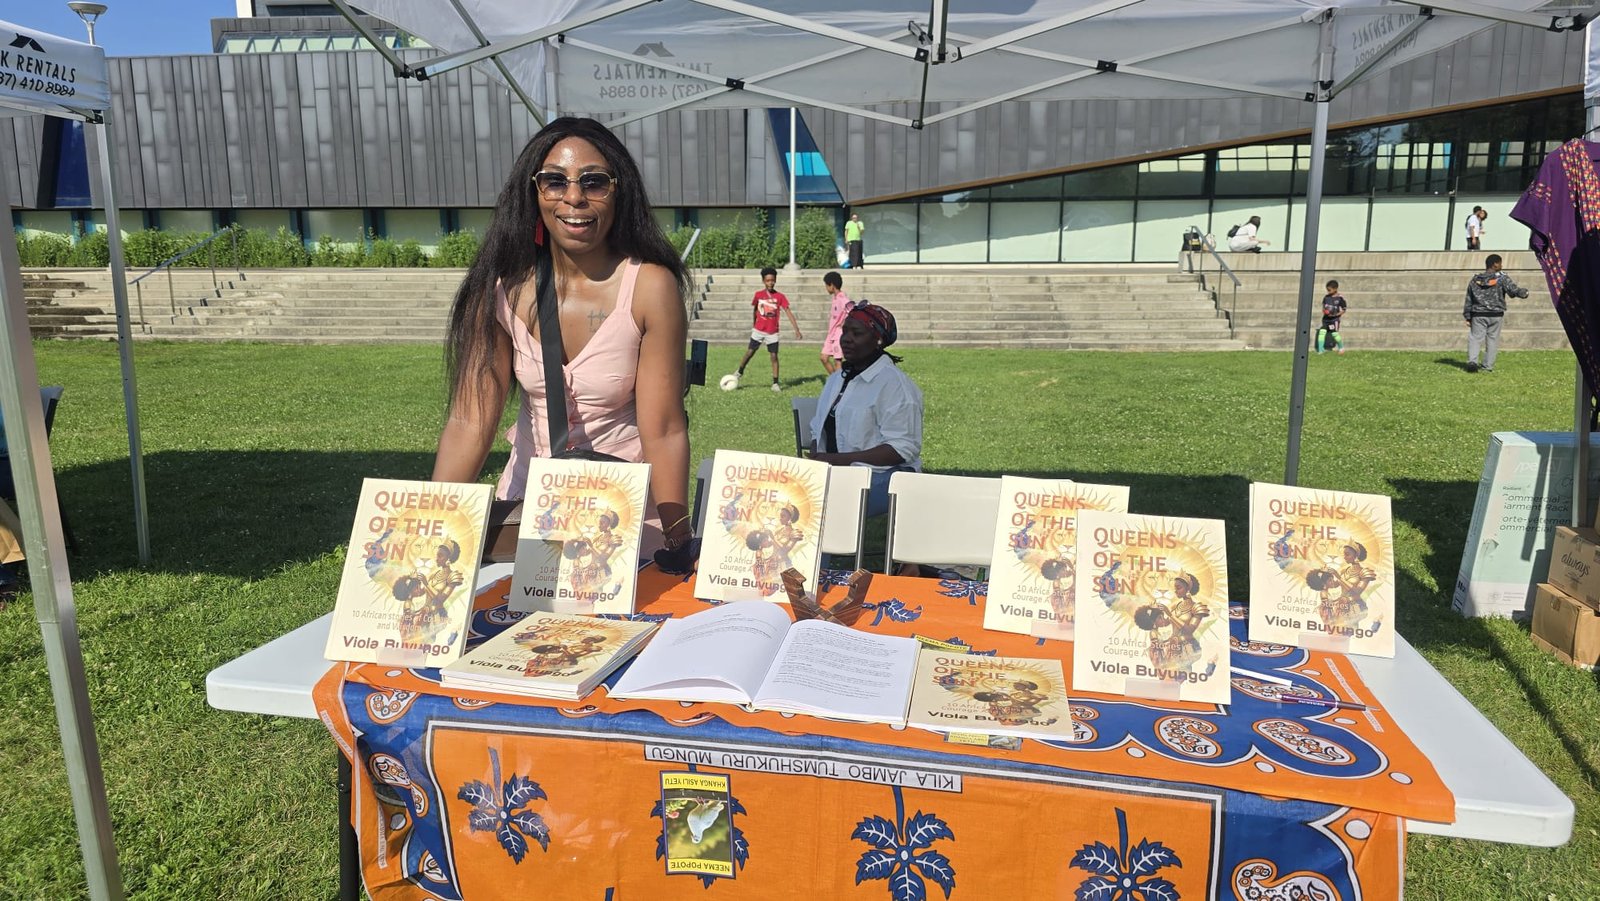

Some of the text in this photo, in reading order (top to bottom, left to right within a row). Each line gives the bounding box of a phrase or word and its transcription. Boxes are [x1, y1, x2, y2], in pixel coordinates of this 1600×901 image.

[16, 54, 76, 83] RENTALS
[20, 76, 44, 92] 410
[45, 81, 76, 97] 8984
[541, 473, 608, 491] QUEENS
[724, 465, 789, 484] QUEENS
[374, 490, 459, 512] QUEENS
[537, 494, 597, 510] OF THE
[721, 485, 778, 503] OF THE
[1014, 491, 1086, 510] QUEENS
[718, 505, 752, 522] SUN
[1269, 499, 1346, 520] QUEENS
[1545, 503, 1569, 512] Rack
[368, 516, 444, 536] OF THE
[534, 514, 569, 531] SUN
[1011, 512, 1075, 531] OF THE
[1500, 524, 1553, 533] ommercial
[1094, 527, 1177, 549] QUEENS
[1268, 520, 1337, 541] OF THE
[1008, 533, 1046, 550] SUN
[362, 541, 407, 561] SUN
[724, 555, 733, 563] 10
[1267, 542, 1308, 560] SUN
[540, 566, 549, 574] 10
[719, 562, 748, 573] Courage
[1093, 552, 1167, 573] OF THE
[1560, 551, 1591, 578] always
[708, 574, 787, 593] Viola Buyung
[1017, 584, 1025, 593] 10
[1028, 586, 1050, 596] Africa
[1092, 577, 1138, 596] SUN
[523, 586, 615, 602] Viola Buyungo
[1012, 592, 1047, 604] Courage
[1282, 595, 1292, 604] 10
[1294, 597, 1318, 607] Africa
[352, 610, 361, 619] 10
[361, 611, 387, 621] African
[388, 612, 413, 621] stoies
[1000, 604, 1074, 623] Viola Buyu
[1276, 603, 1313, 615] Courage
[376, 622, 391, 630] and
[538, 617, 609, 629] QUEENS
[1265, 615, 1374, 638] Viola Buyungo
[343, 635, 379, 650] Viola
[1108, 637, 1119, 646] 10
[1121, 638, 1147, 648] Africa
[1103, 645, 1139, 658] Courage
[469, 659, 571, 677] Viola Buyungo
[935, 657, 1016, 671] QUEENS
[1090, 660, 1208, 683] Viola Buyungo
[932, 675, 977, 687] SUN
[934, 666, 1006, 680] OF THE
[928, 710, 1050, 726] Viola Buyungo
[652, 746, 954, 790] KILA JAMBO TUMSHUKURU MUNGU
[665, 778, 682, 786] YETU
[700, 779, 726, 788] KHANGA
[671, 861, 730, 872] NEEMA POPOTE
